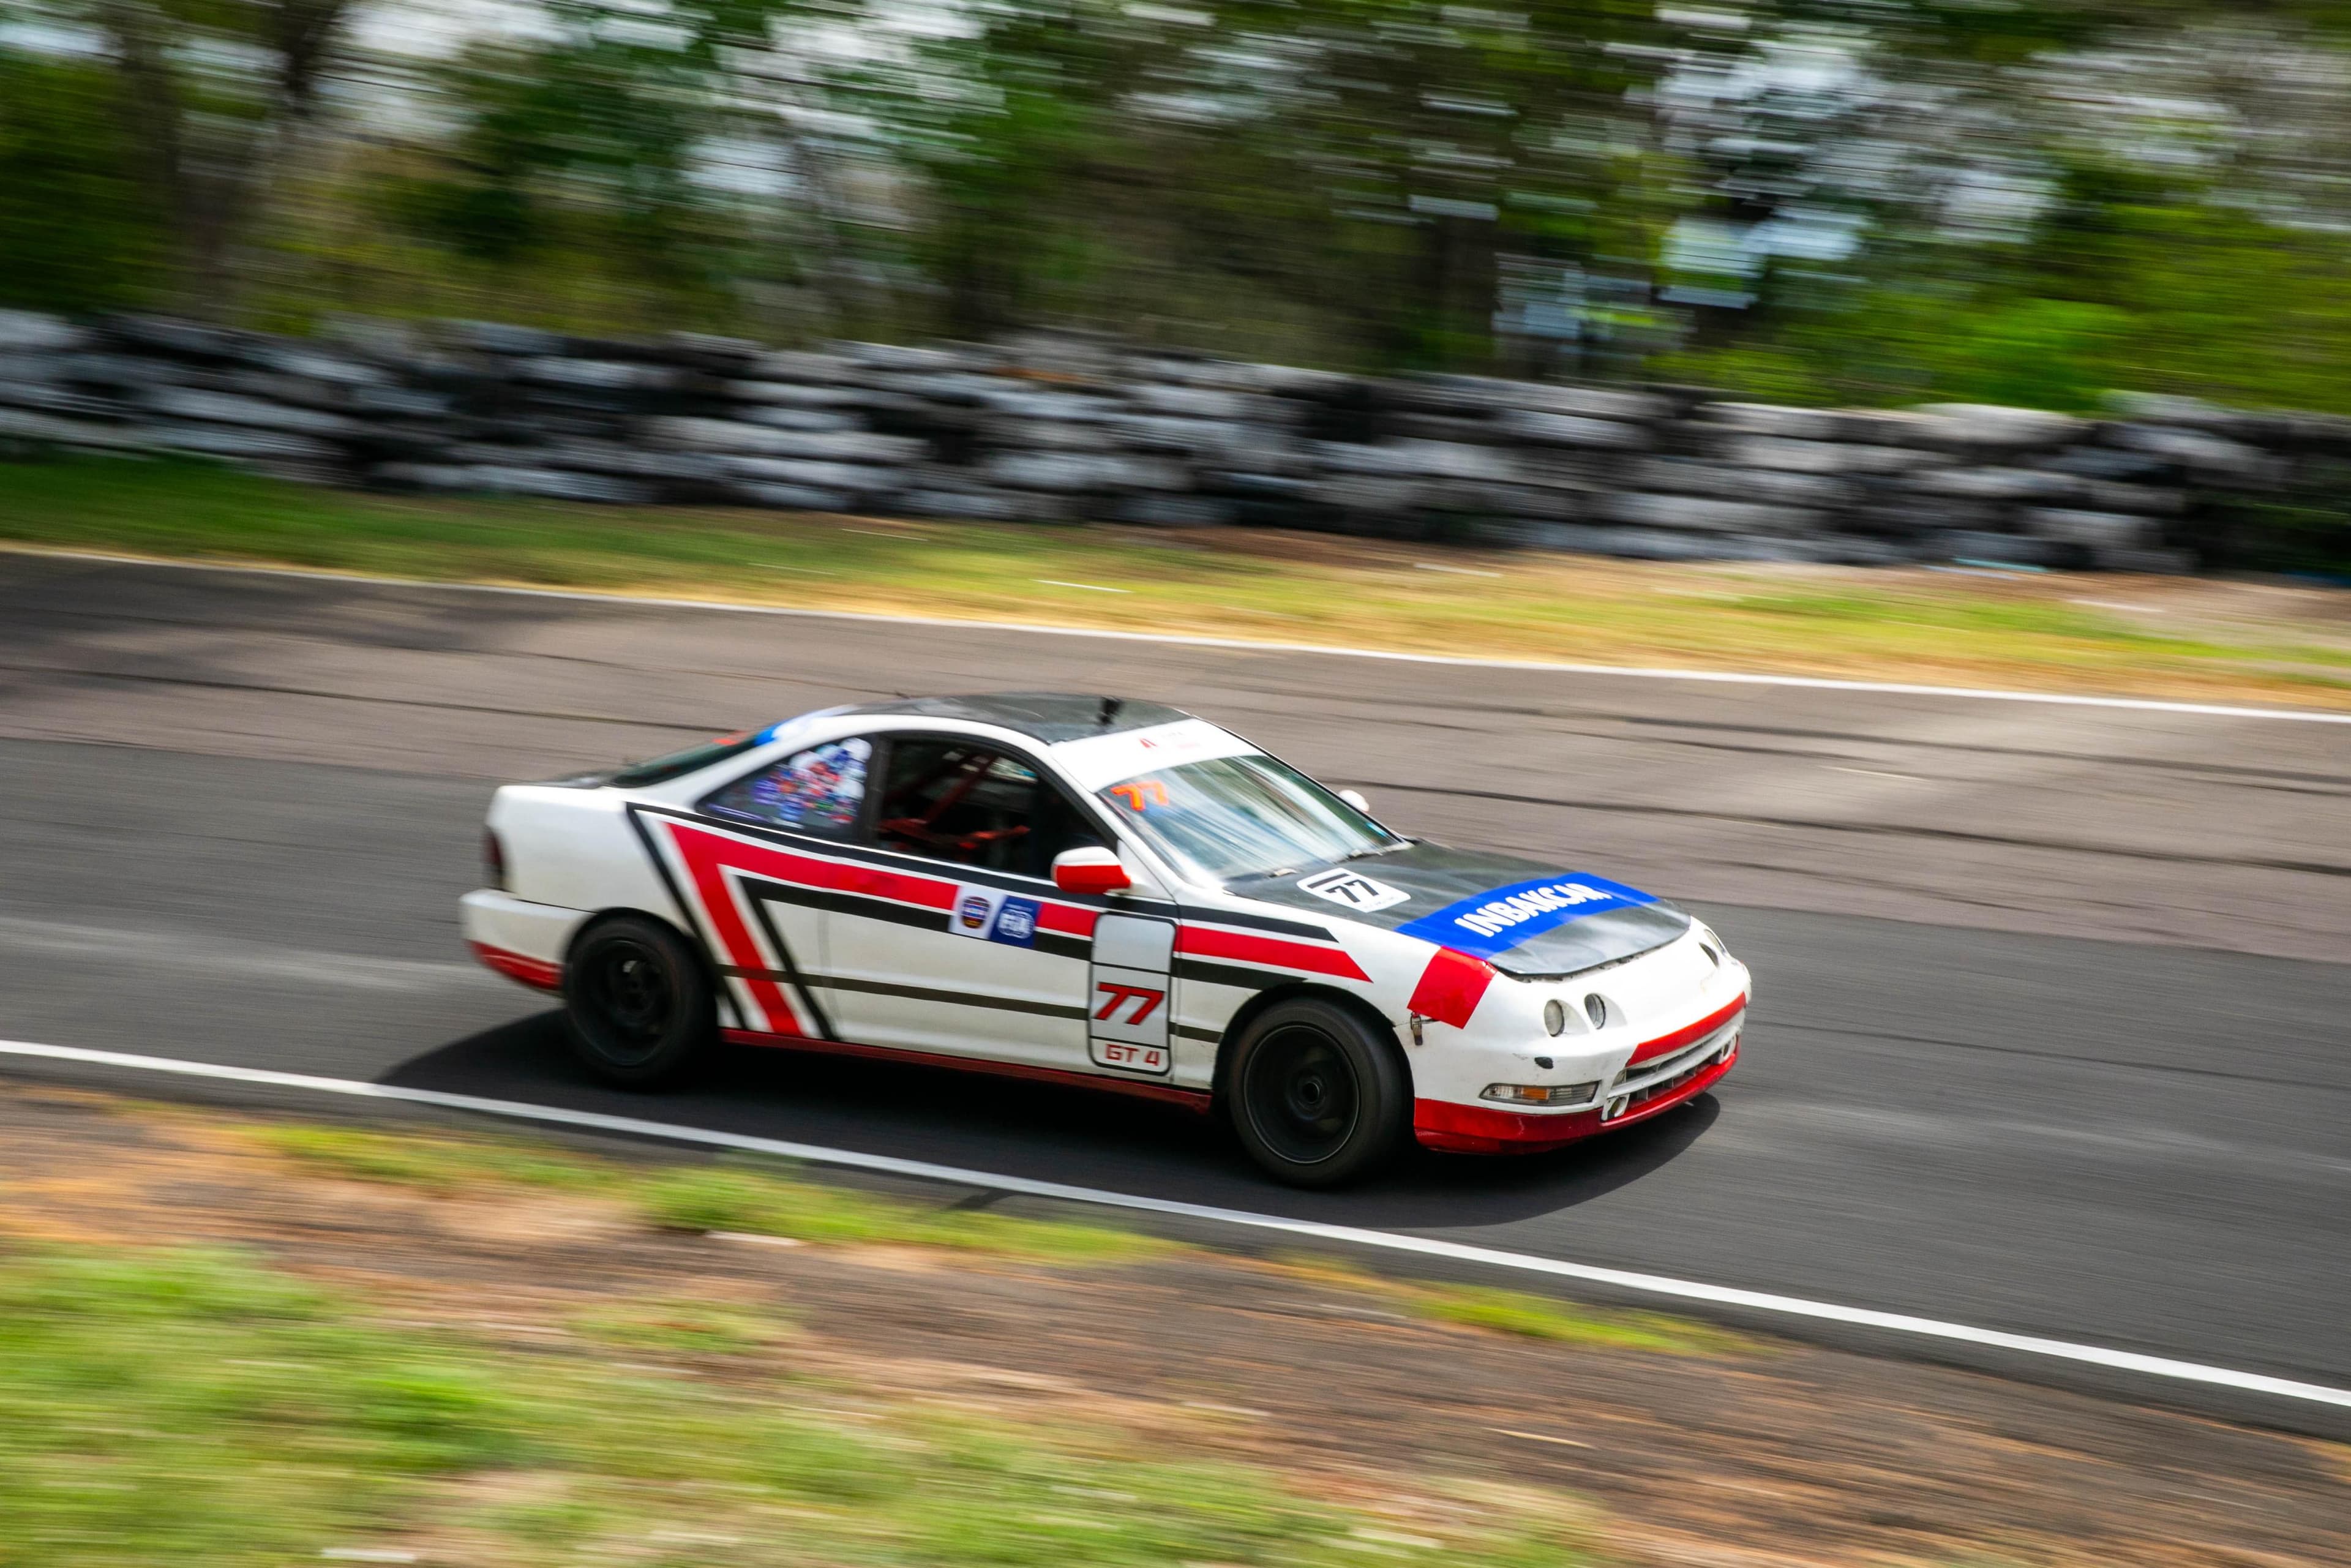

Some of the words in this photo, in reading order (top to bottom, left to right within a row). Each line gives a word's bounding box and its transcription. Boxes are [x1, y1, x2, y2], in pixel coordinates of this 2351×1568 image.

[1110, 780, 1169, 812] 77
[1324, 879, 1379, 903] 77
[1454, 883, 1613, 937] INBAKCAR
[1093, 981, 1166, 1026] 77
[1106, 1043, 1139, 1062] GT
[1144, 1050, 1160, 1067] 4
